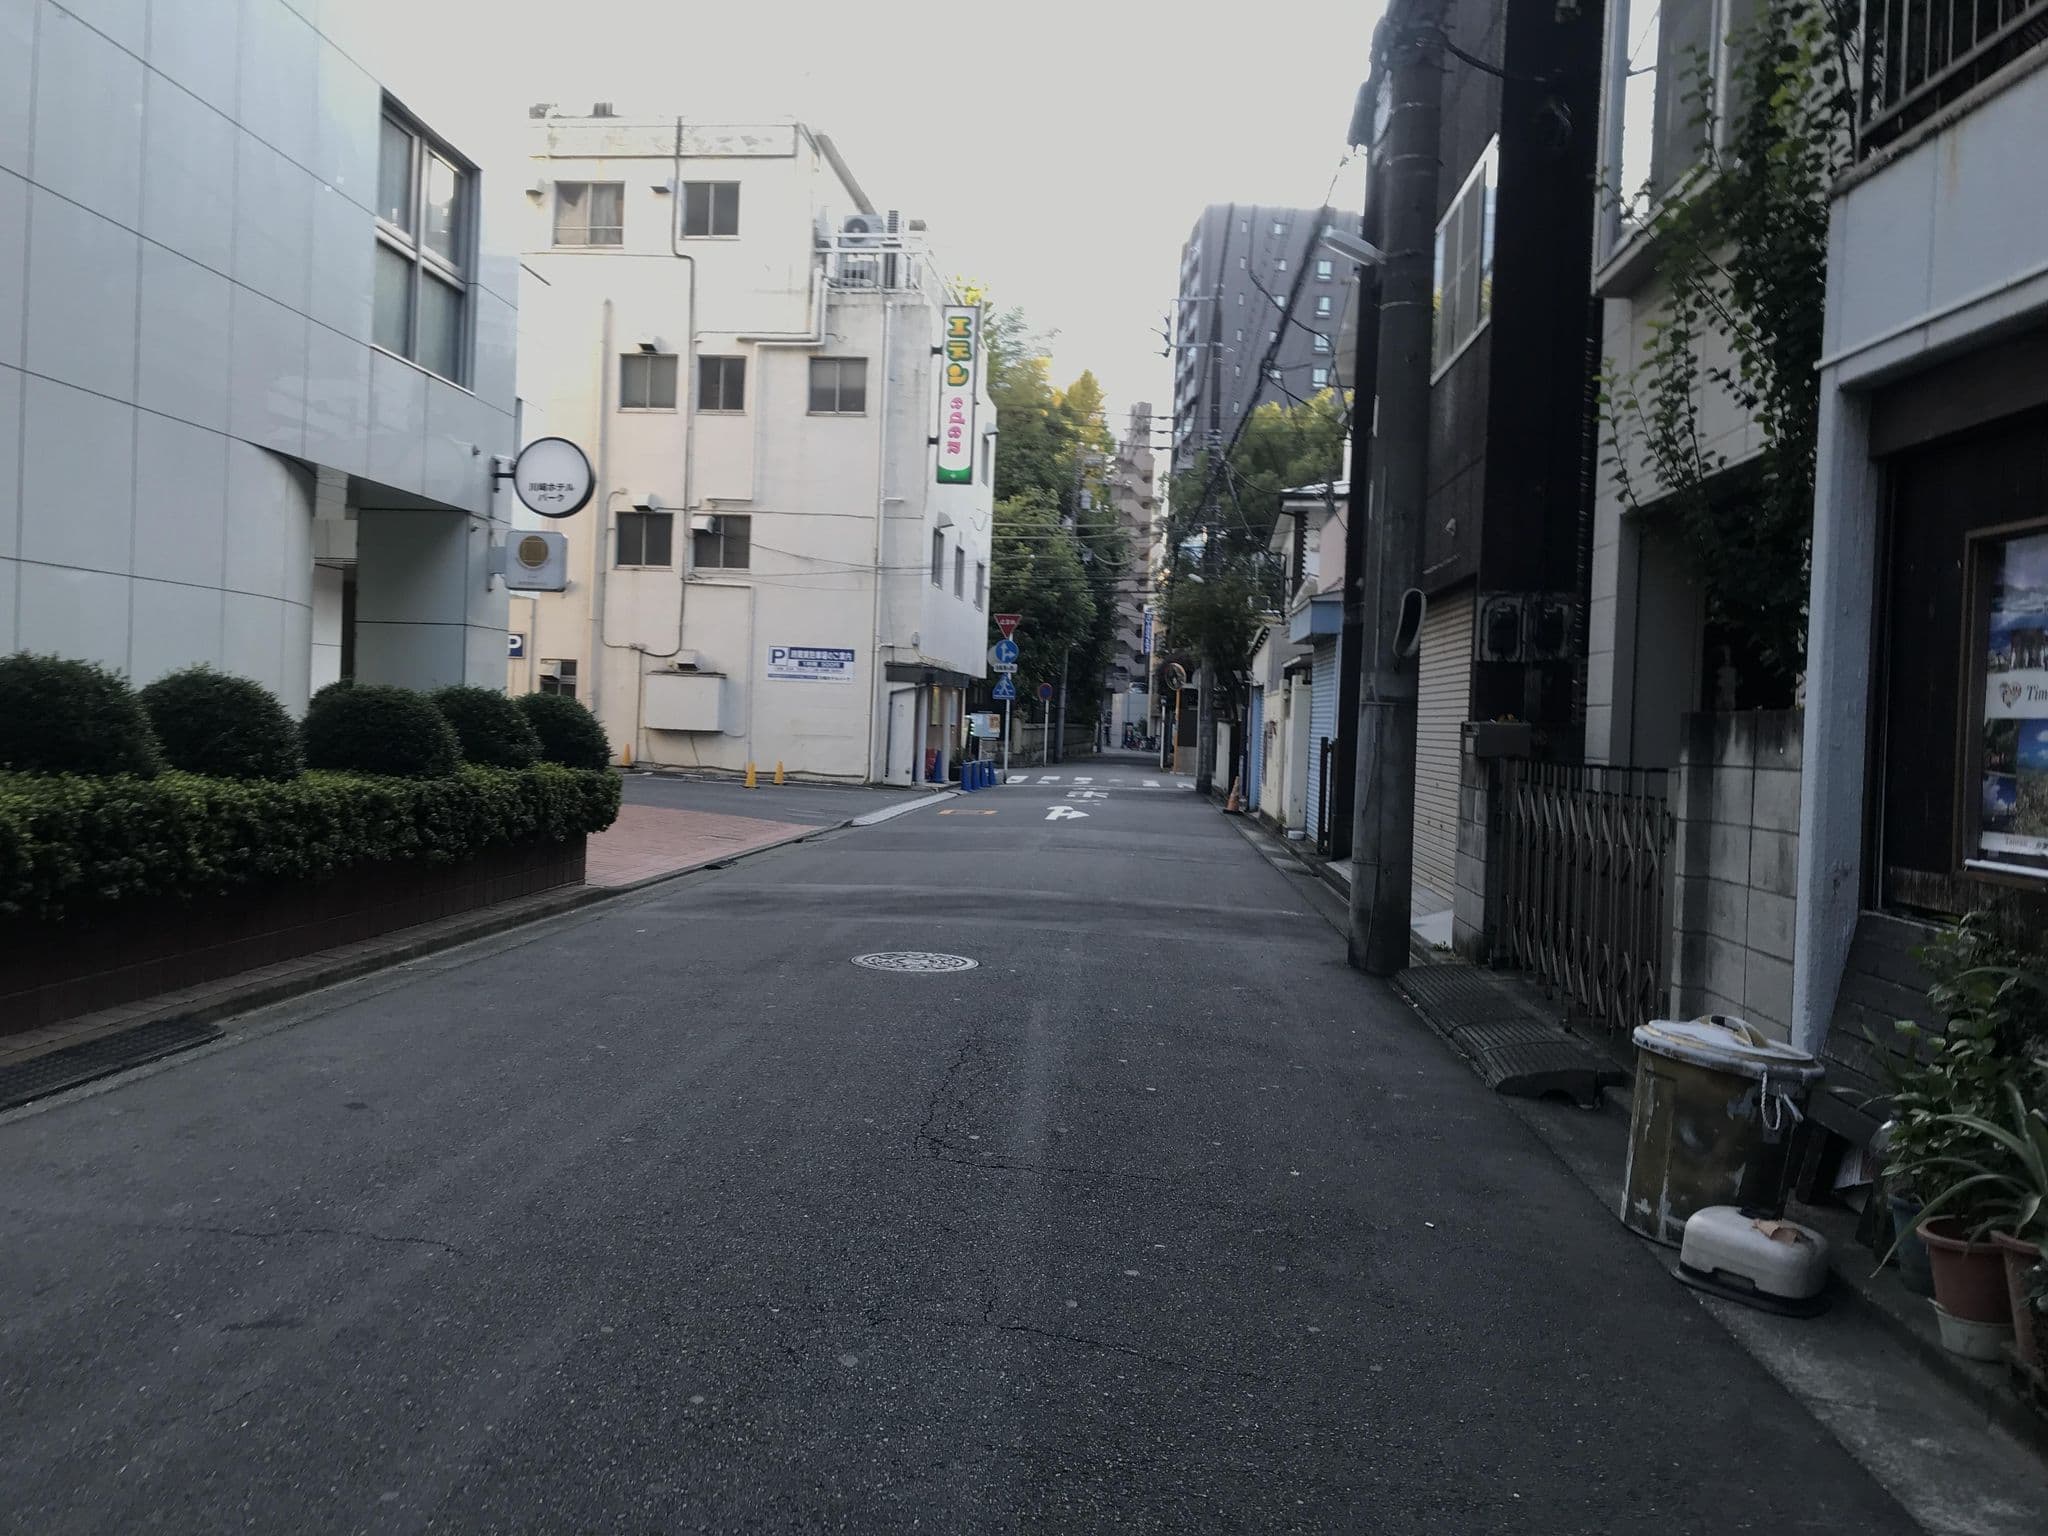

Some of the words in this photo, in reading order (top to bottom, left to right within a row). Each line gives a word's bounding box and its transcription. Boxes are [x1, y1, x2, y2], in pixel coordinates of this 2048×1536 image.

[948, 397, 966, 455] eden
[507, 635, 522, 656] P
[772, 649, 786, 664] P
